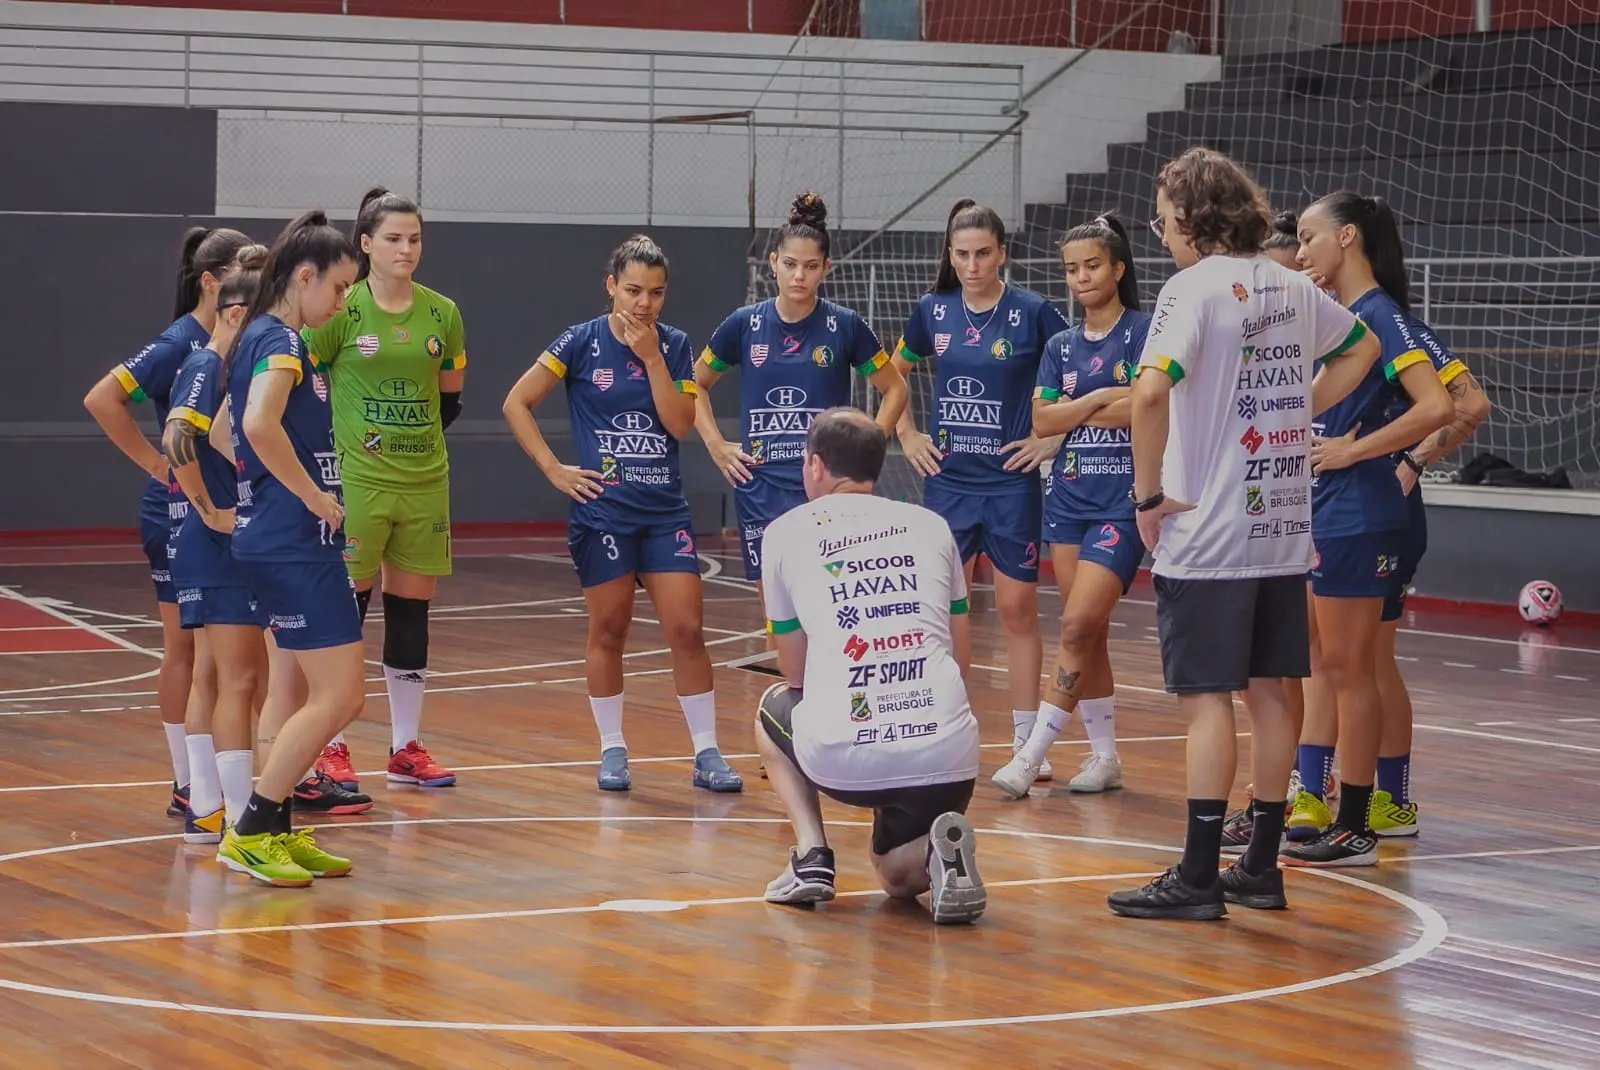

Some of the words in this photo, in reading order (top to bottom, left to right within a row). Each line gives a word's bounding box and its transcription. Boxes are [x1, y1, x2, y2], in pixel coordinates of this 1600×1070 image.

[1151, 296, 1177, 337] HAVA
[1393, 314, 1417, 349] HAVAN
[552, 334, 574, 356] HAVA
[1255, 344, 1301, 362] SICOOB
[1420, 332, 1450, 364] HAVAN
[1237, 365, 1303, 390] HAVAN
[187, 372, 206, 408] HAVAN
[393, 381, 405, 396] H
[958, 380, 971, 395] H
[780, 390, 794, 405] H
[1261, 396, 1305, 412] UNIFEBE
[365, 401, 430, 422] HAVAN
[939, 402, 1001, 425] HAVAN
[625, 414, 639, 429] H
[953, 434, 992, 445] PREFEITURA
[1068, 426, 1130, 444] HAVAN
[1268, 428, 1306, 444] HORT
[390, 442, 436, 453] BRUSQUE
[599, 435, 667, 454] HAVAN
[953, 442, 1002, 455] BRUSQUE
[1081, 456, 1120, 464] PREFEITURA
[1121, 456, 1132, 464] DE
[1244, 458, 1270, 481] ZF
[1273, 455, 1306, 479] SPORT
[1081, 464, 1132, 475] BRUSQUE
[1270, 495, 1308, 508] BRUSQUE
[603, 534, 620, 561] 3
[819, 525, 908, 557] Italianinha
[747, 542, 759, 566] 5
[847, 555, 915, 573] SICOOB
[829, 574, 918, 604] HAVAN
[865, 602, 921, 619] UNIFEBE
[873, 632, 924, 651] HORT
[848, 664, 876, 688] ZF
[879, 657, 927, 684] SPORT
[876, 690, 920, 702] PREFEITURA
[922, 688, 933, 696] DE
[878, 697, 934, 713] BRUSQUE
